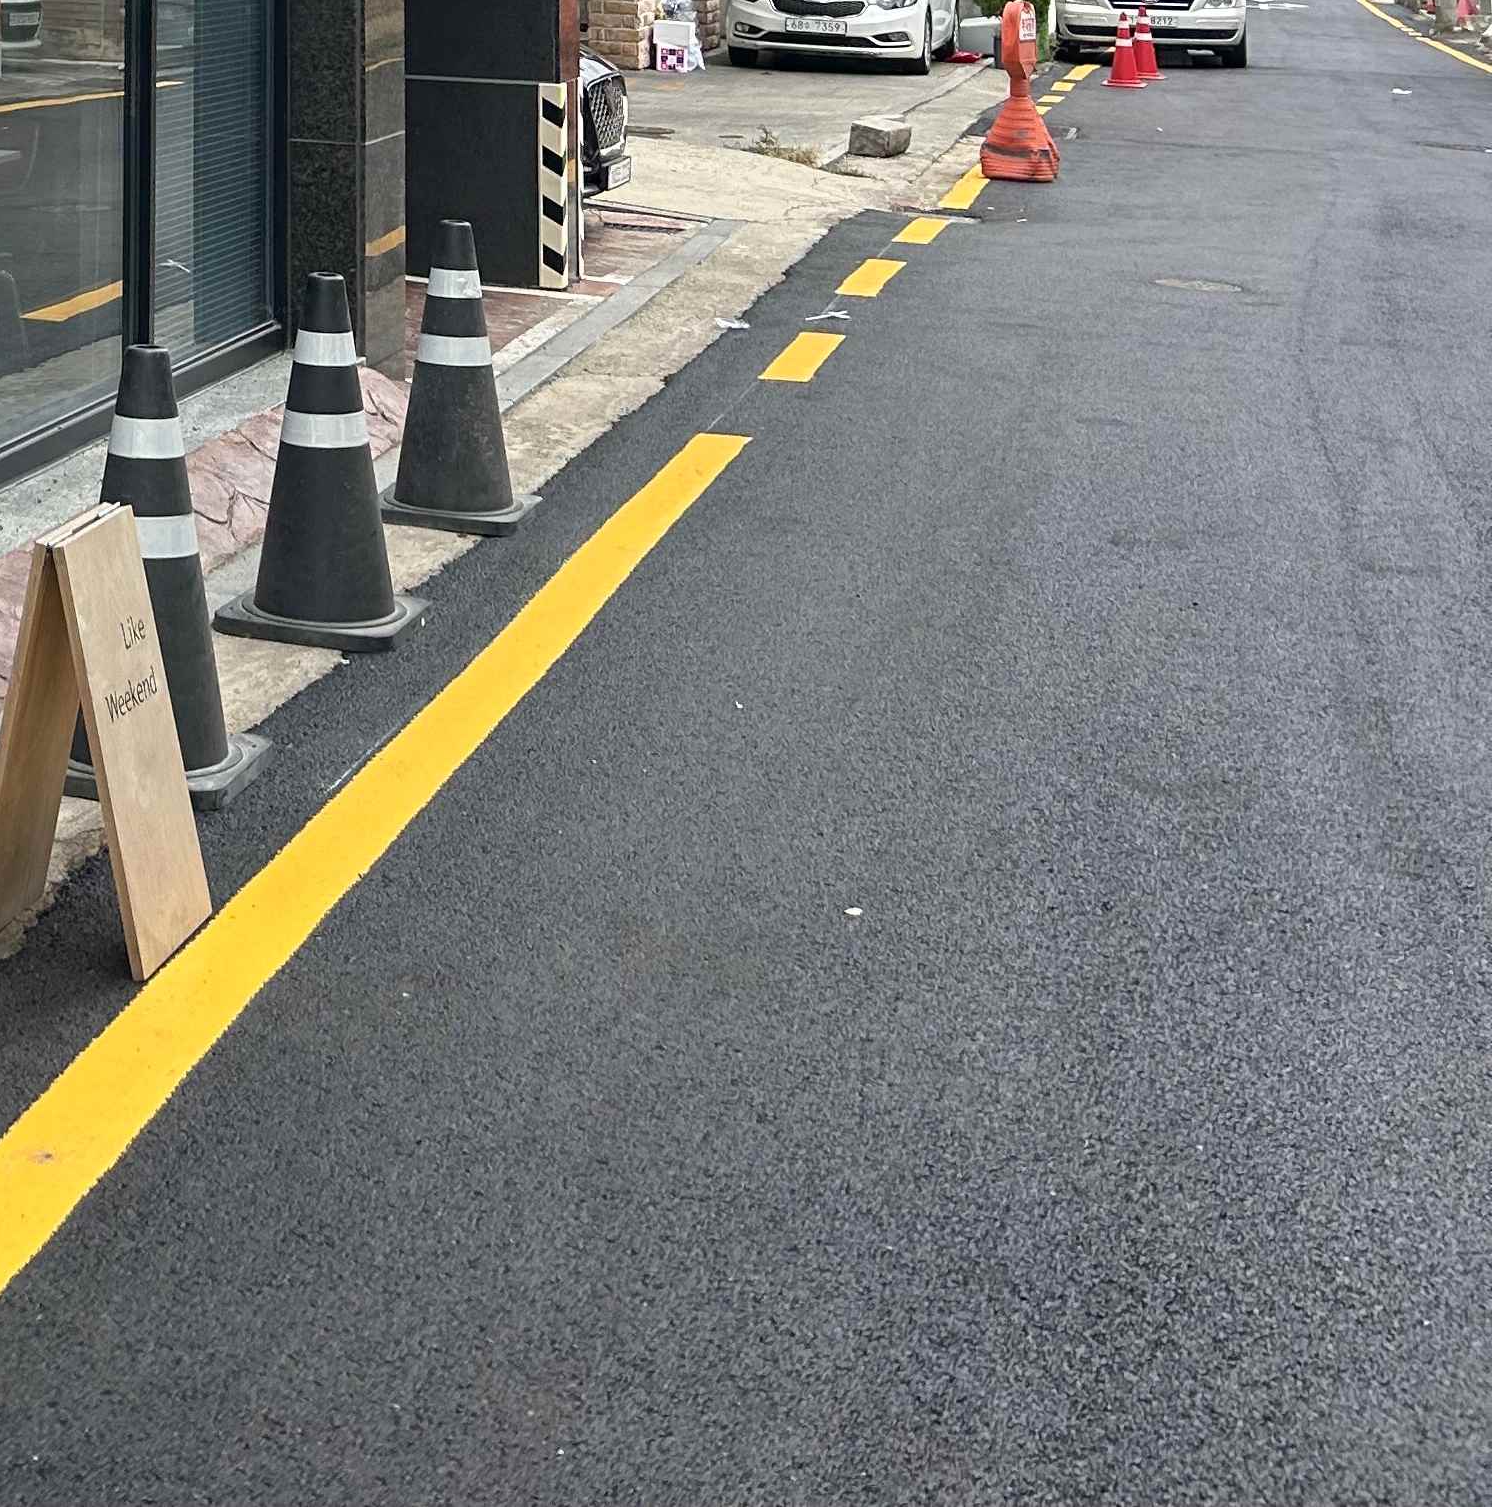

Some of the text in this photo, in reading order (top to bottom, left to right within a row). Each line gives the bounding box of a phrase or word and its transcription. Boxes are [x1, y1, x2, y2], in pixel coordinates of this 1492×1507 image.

[814, 21, 841, 32] 7359
[120, 616, 146, 649] Like
[105, 665, 158, 723] Weekend
